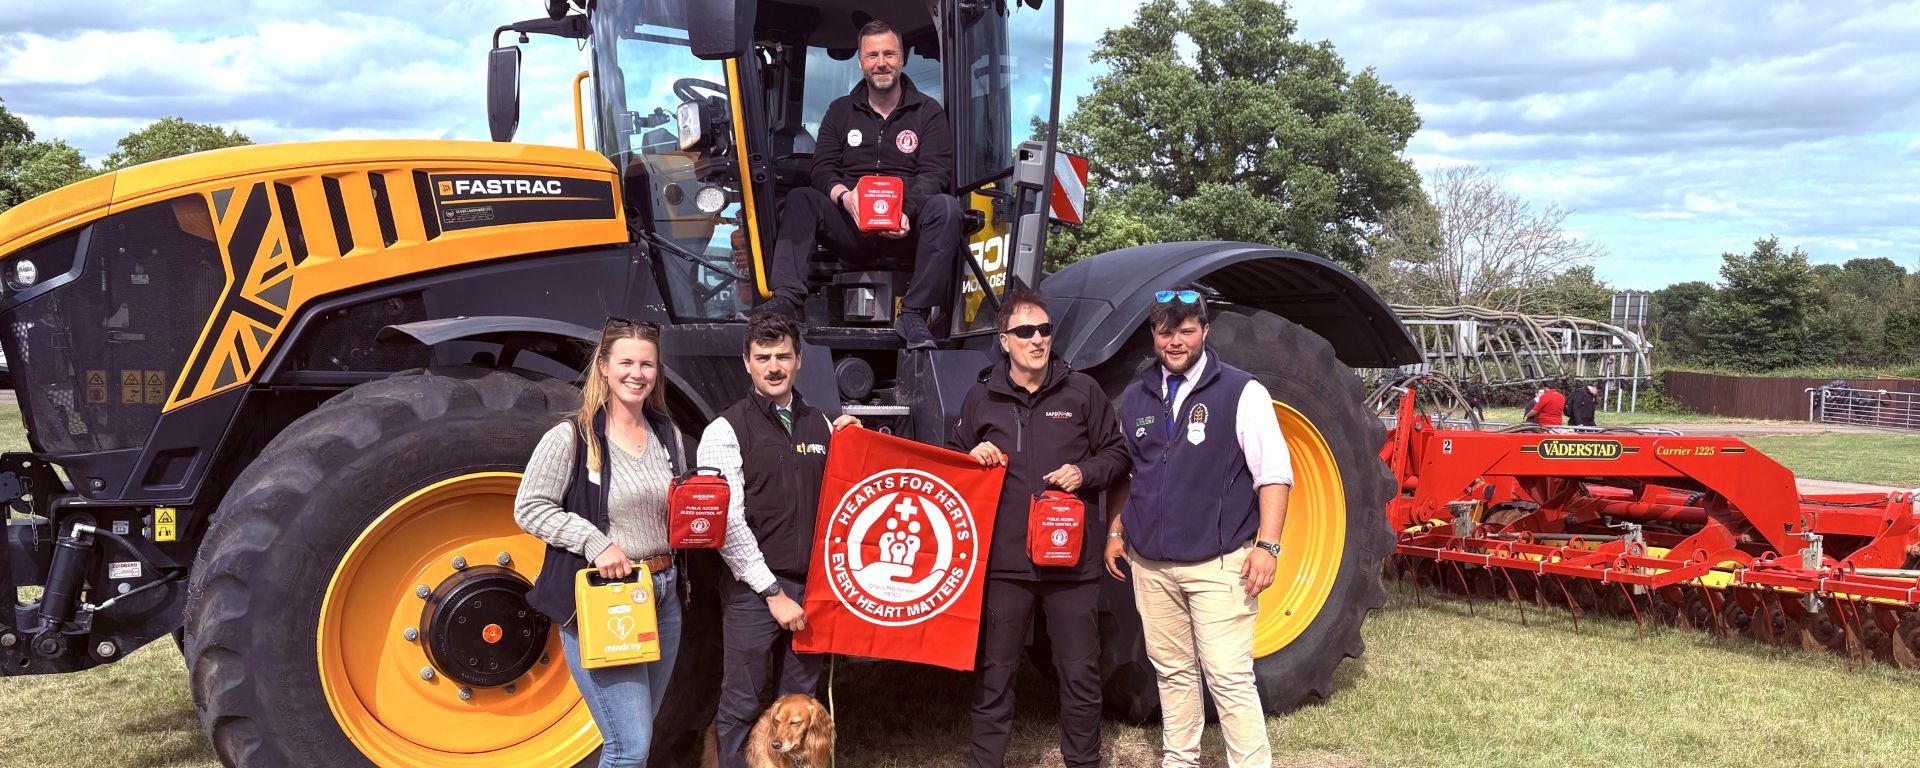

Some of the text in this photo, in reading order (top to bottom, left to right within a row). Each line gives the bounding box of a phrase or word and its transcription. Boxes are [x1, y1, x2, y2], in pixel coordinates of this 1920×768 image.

[455, 179, 562, 195] FASTRAC
[1444, 440, 1451, 450] 2
[1543, 440, 1617, 456] VÄDERSTAD
[1656, 446, 1715, 456] Carrier 1225
[838, 475, 970, 541] HEARTS FOR HERTS
[832, 552, 964, 618] EVERY HEART MATTERS
[604, 642, 642, 653] mindray
